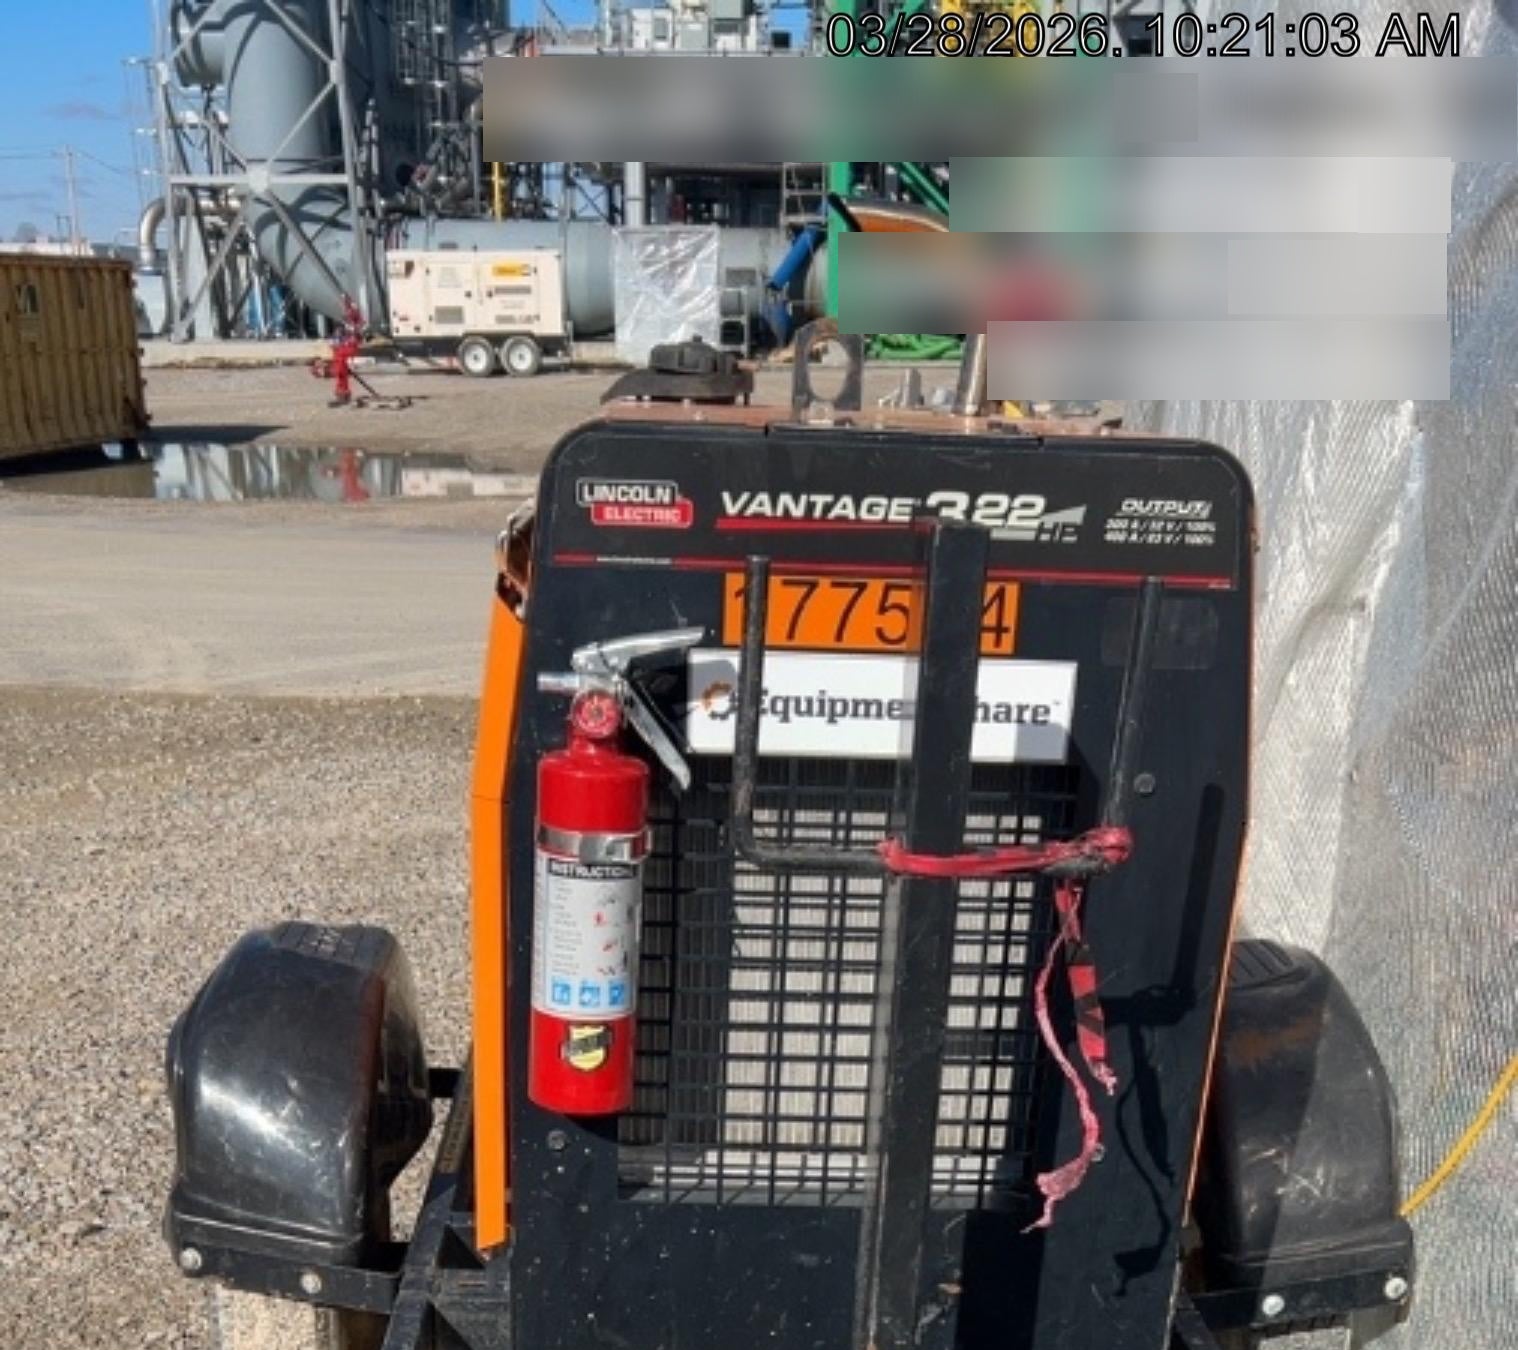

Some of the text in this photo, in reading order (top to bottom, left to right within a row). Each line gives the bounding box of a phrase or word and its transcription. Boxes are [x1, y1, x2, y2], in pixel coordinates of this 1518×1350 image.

[582, 483, 671, 505] LINCOLN
[602, 505, 682, 524] ELECTRIC
[720, 491, 915, 523] VANTAGE
[926, 490, 1046, 529] 322
[734, 579, 1010, 649] 7754
